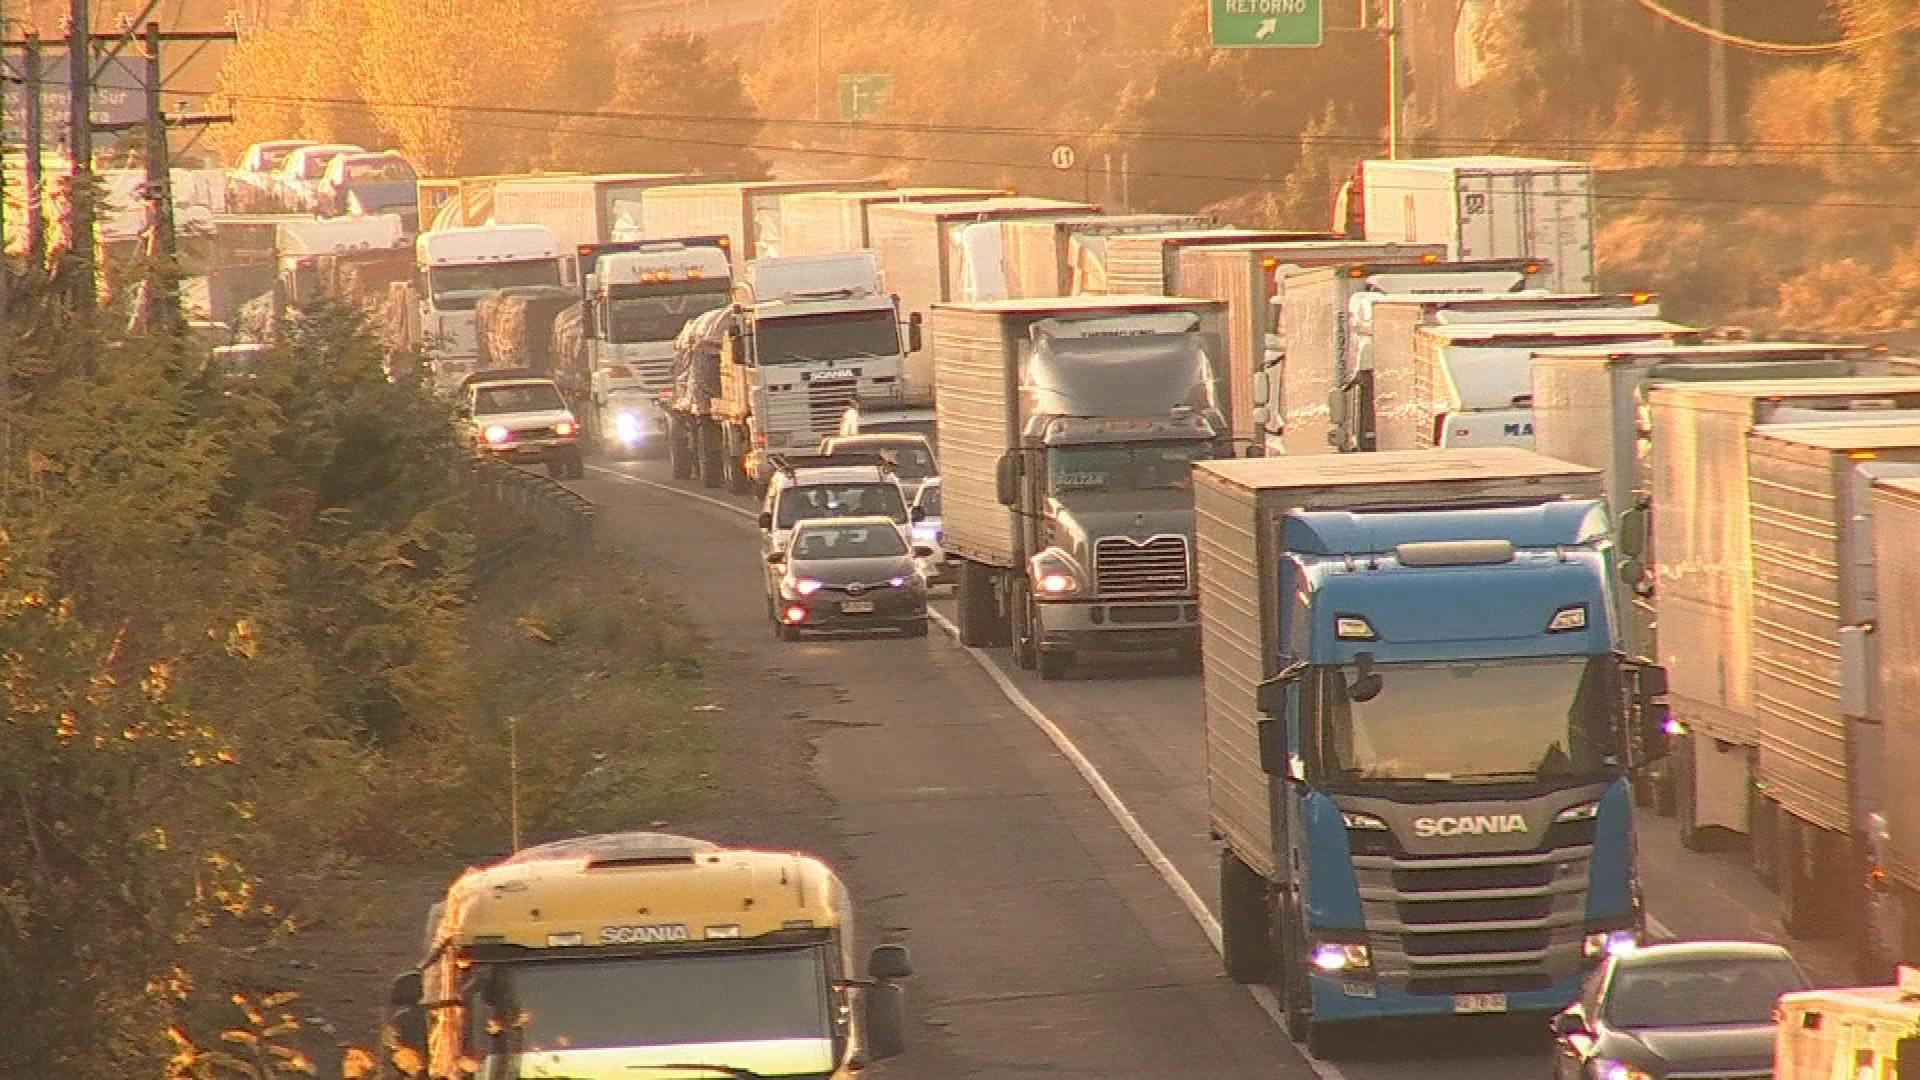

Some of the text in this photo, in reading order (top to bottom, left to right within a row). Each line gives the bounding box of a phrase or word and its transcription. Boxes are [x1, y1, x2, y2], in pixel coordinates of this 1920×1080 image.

[1226, 0, 1306, 14] RETORNO
[1415, 815, 1529, 837] SCANIA
[600, 925, 688, 944] SCANIA
